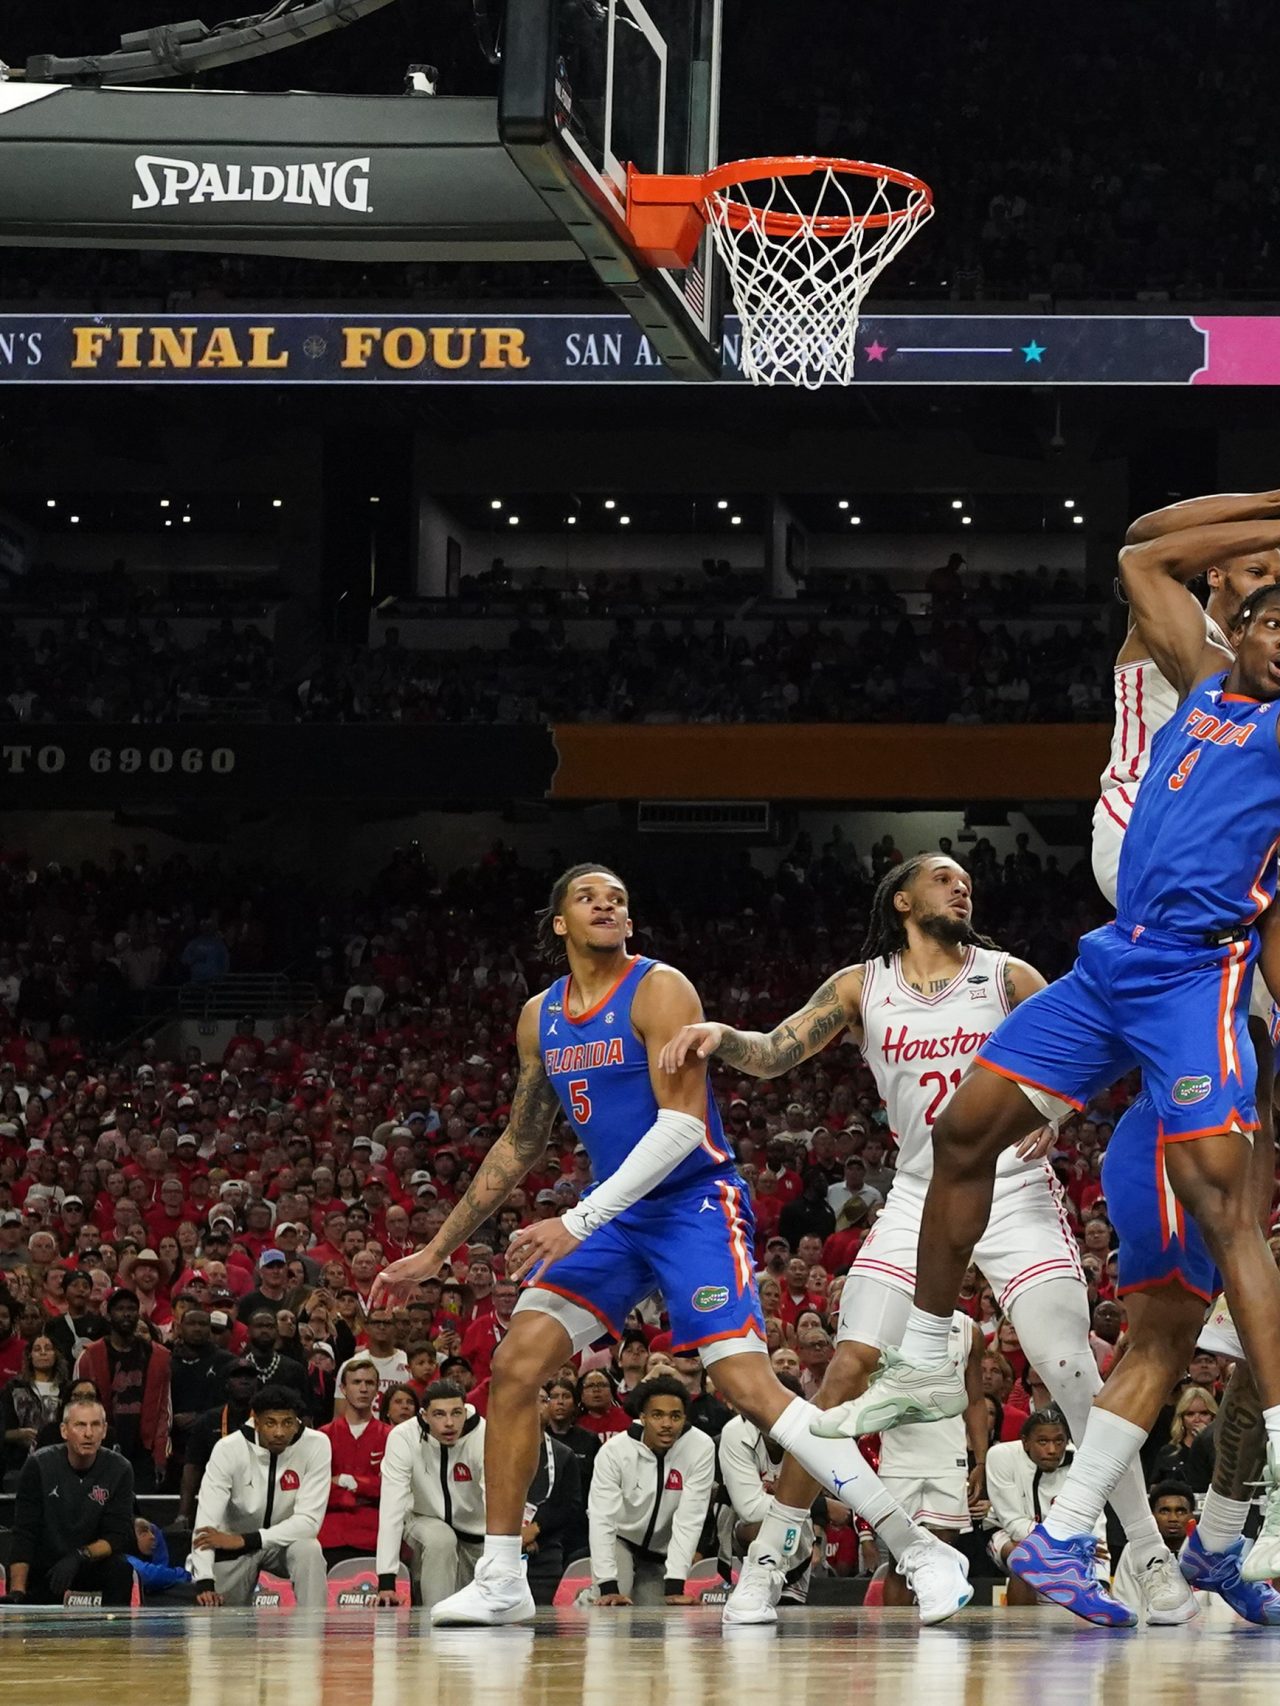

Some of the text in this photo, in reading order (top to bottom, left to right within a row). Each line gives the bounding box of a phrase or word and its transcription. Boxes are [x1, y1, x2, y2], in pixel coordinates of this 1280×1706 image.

[132, 154, 374, 213] SPALDING
[71, 327, 288, 368] FINAL
[341, 327, 530, 368] FOUR
[566, 333, 622, 366] SAN
[2, 745, 236, 773] TO 69060
[1168, 748, 1201, 791] 9
[544, 1038, 624, 1075] FLORIDA
[569, 1079, 592, 1124] 5
[255, 1595, 279, 1605] FOUR
[339, 1594, 364, 1604] FINAL
[702, 1593, 727, 1603] FINAL
